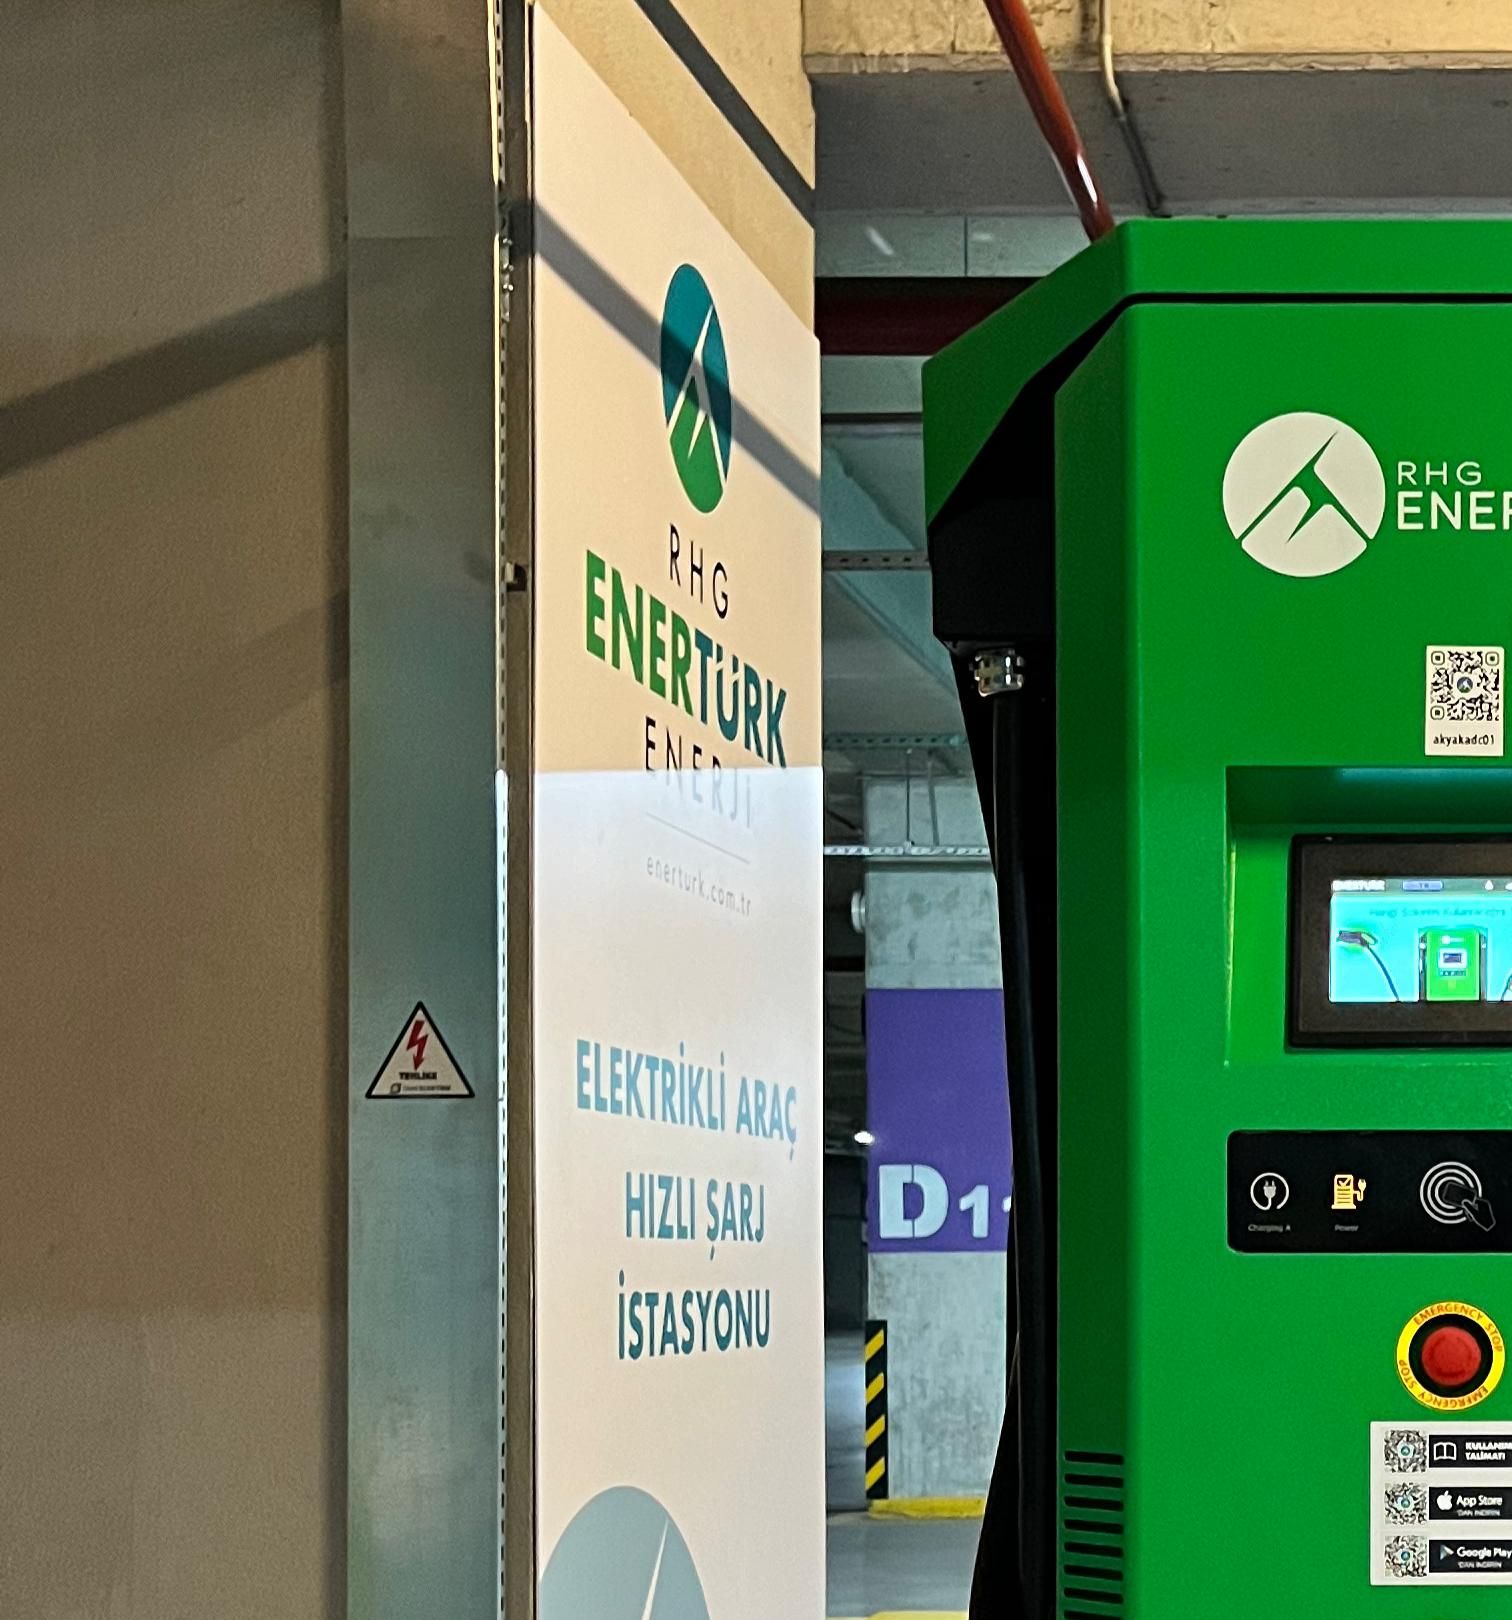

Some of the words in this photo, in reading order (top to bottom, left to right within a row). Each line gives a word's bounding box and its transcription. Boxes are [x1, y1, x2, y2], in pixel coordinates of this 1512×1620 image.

[1397, 461, 1482, 485] RHG
[669, 523, 729, 619] RHG
[586, 548, 788, 769] ENERTÜRK
[1433, 733, 1495, 748] akyakadc01
[646, 855, 752, 917] enerturk.com.tr
[576, 1038, 727, 1132] ELEKTRİKLİ
[735, 1075, 798, 1162] ARAÇ
[625, 1171, 696, 1241] HIZLI
[706, 1178, 766, 1261] ŞARJ
[878, 1163, 1012, 1239] D1
[617, 1269, 771, 1361] İSTASYONU
[1413, 1303, 1484, 1326] EMERGENCY
[1485, 1323, 1503, 1352] STOP
[1418, 1386, 1489, 1408] EMERGENCY
[1456, 1495, 1477, 1508] App
[1478, 1495, 1503, 1506] Store
[1456, 1546, 1492, 1560] Google
[1493, 1547, 1512, 1560] Play
